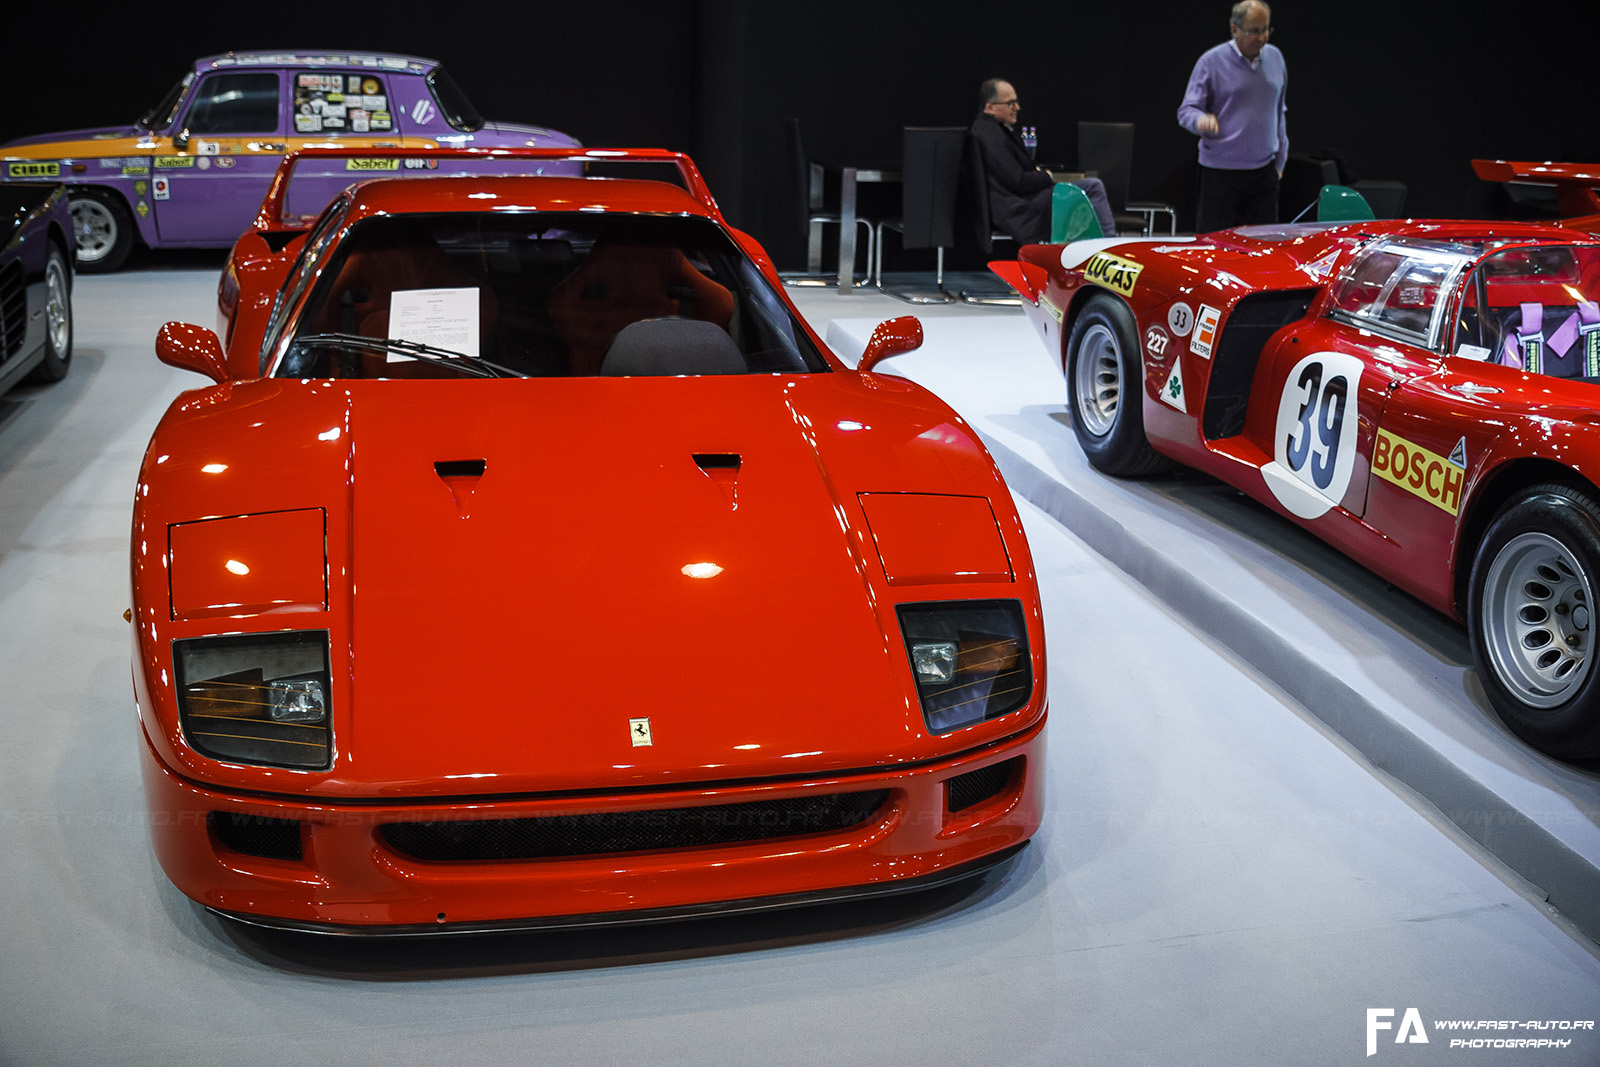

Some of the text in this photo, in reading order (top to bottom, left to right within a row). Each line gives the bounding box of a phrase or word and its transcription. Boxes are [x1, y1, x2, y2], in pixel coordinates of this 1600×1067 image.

[1087, 254, 1137, 291] LUCAS
[1174, 310, 1187, 328] 33
[1146, 331, 1169, 355] 227
[1191, 341, 1210, 356] FILTERS
[1286, 361, 1348, 490] 39
[1373, 432, 1463, 510] BOSCH
